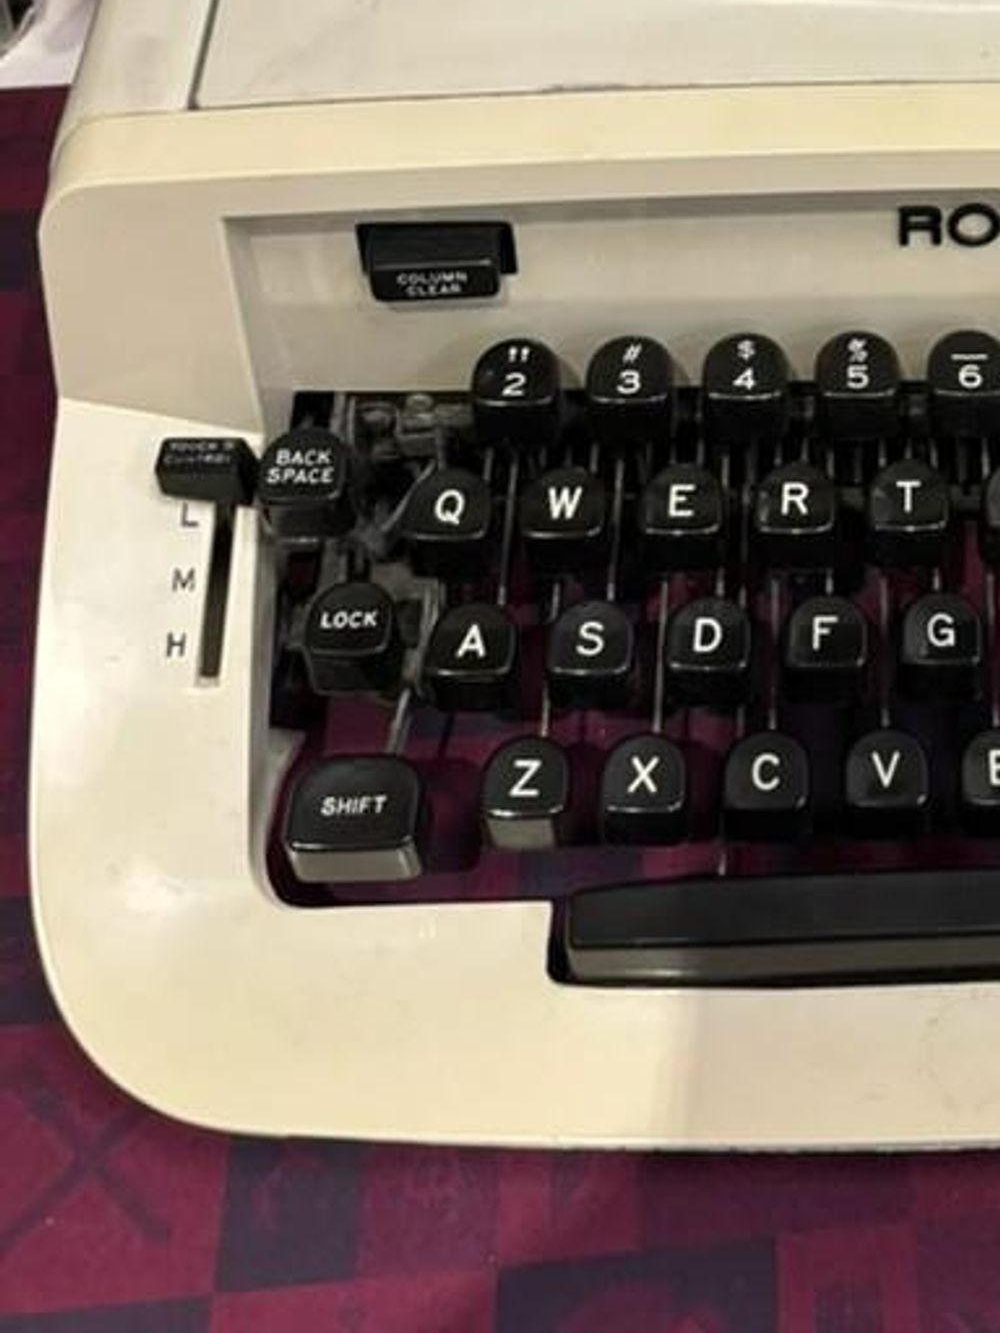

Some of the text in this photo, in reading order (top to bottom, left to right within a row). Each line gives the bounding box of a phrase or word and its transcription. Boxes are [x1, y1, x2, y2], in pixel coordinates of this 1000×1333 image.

[397, 271, 468, 287] COLUMN
[407, 283, 461, 296] CLEAR
[622, 344, 642, 363] #
[737, 340, 755, 361] $
[502, 372, 526, 397] 2
[617, 369, 641, 394] 3
[733, 368, 755, 390] 4
[847, 364, 869, 389] 5
[958, 364, 983, 388] 6
[275, 449, 330, 466] BACK
[266, 467, 334, 484] SPACE
[434, 489, 465, 525] Q
[548, 486, 583, 519] W
[668, 484, 695, 517] E
[781, 482, 809, 515] R
[895, 480, 921, 512] T
[180, 502, 200, 528] L
[171, 568, 196, 591] M
[320, 611, 377, 629] LOCK
[812, 615, 838, 650] F
[927, 613, 955, 647] G
[165, 632, 186, 658] H
[457, 624, 485, 657] A
[576, 621, 604, 656] S
[693, 617, 722, 653] D
[509, 759, 541, 797] Z
[627, 756, 659, 793] X
[752, 753, 780, 791] C
[872, 751, 900, 787] V
[320, 795, 387, 817] SHIFT
